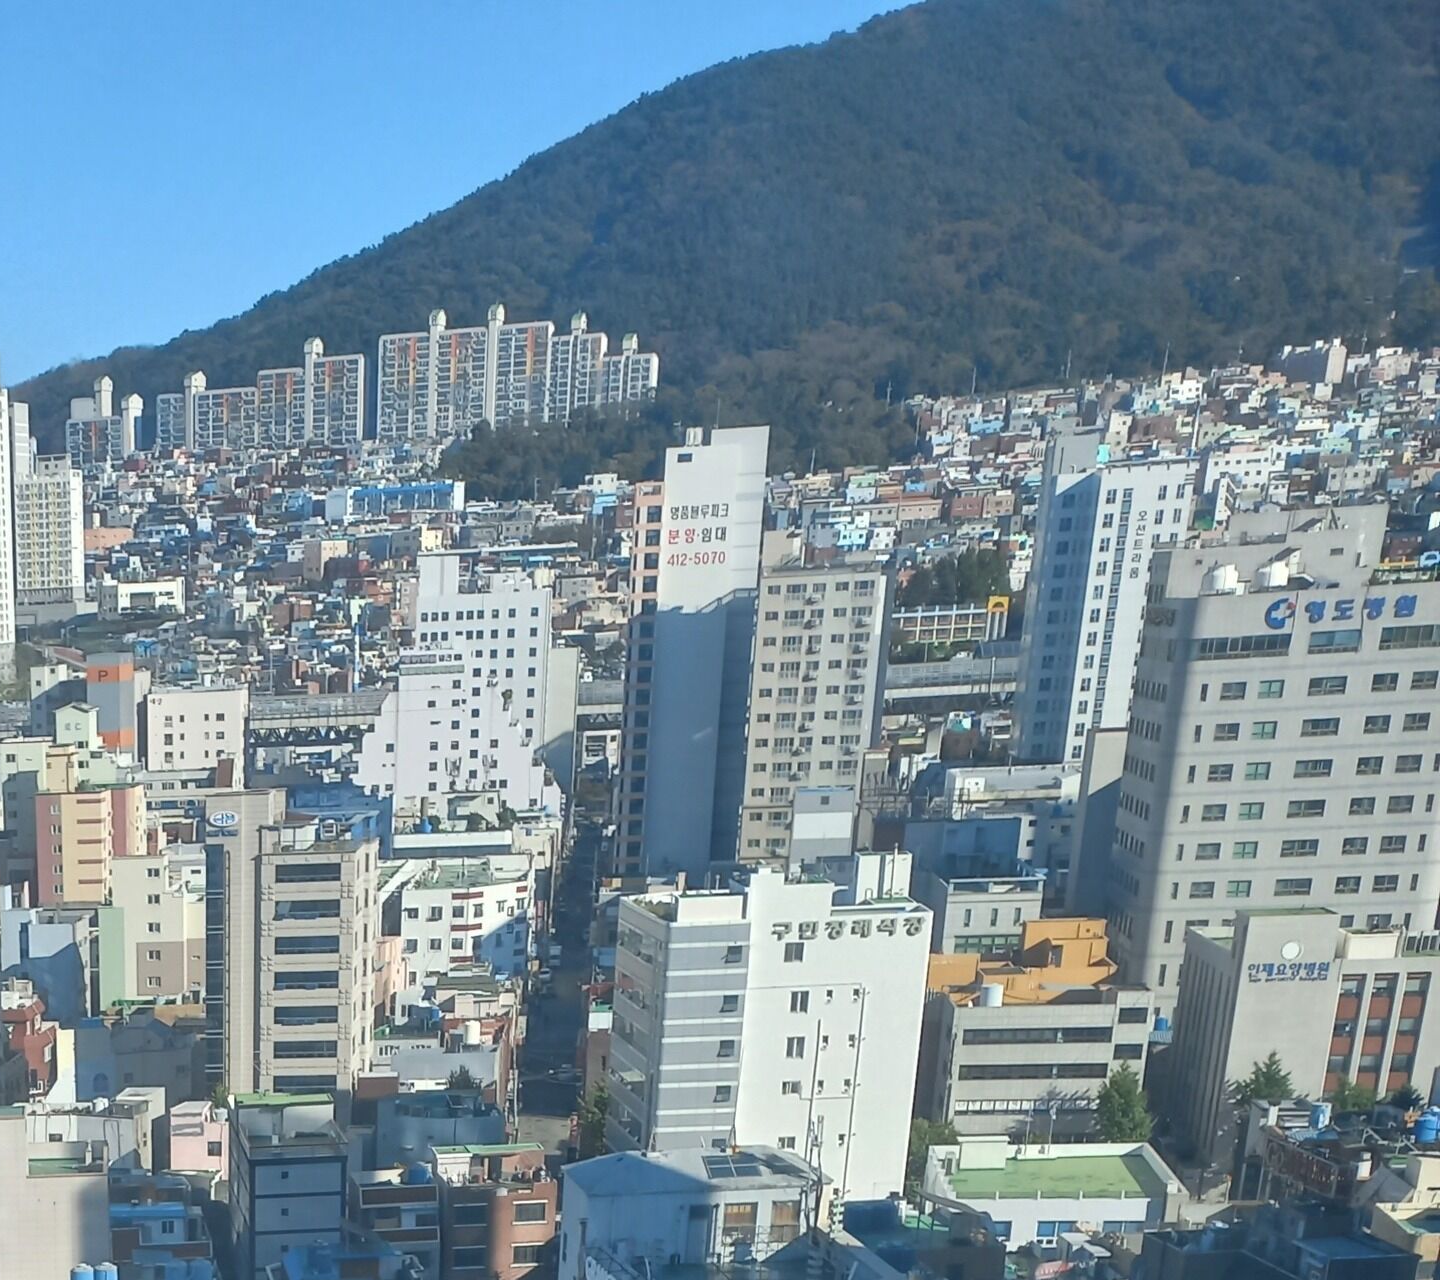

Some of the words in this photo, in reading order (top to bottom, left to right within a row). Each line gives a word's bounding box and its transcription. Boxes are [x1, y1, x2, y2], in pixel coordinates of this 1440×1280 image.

[667, 551, 726, 566] 412-5070
[1304, 594, 1418, 624] 영도병원
[98, 670, 108, 682] P
[771, 917, 926, 941] 구민장례식장
[1248, 961, 1330, 977] 인재요양병원
